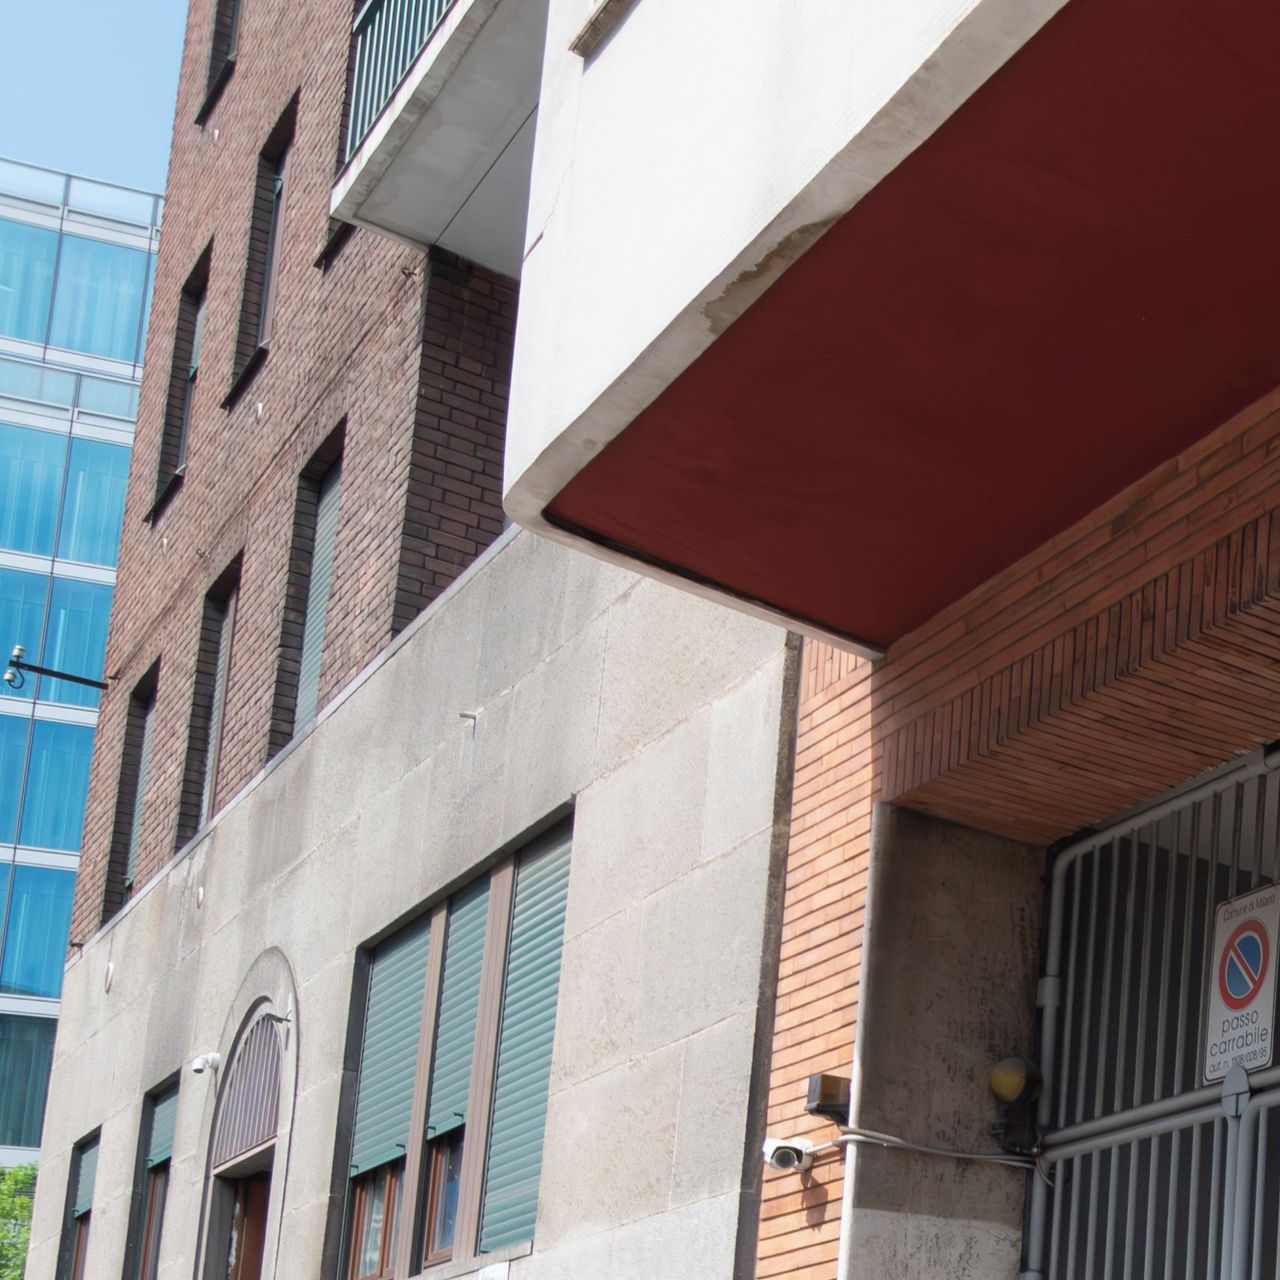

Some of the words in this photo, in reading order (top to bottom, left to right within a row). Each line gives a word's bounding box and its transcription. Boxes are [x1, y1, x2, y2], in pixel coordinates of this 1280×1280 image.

[1223, 904, 1248, 922] Comune
[1248, 900, 1255, 913] di
[1256, 894, 1276, 909] Milano
[1221, 1009, 1259, 1038] passo
[1209, 1026, 1269, 1057] carrabile
